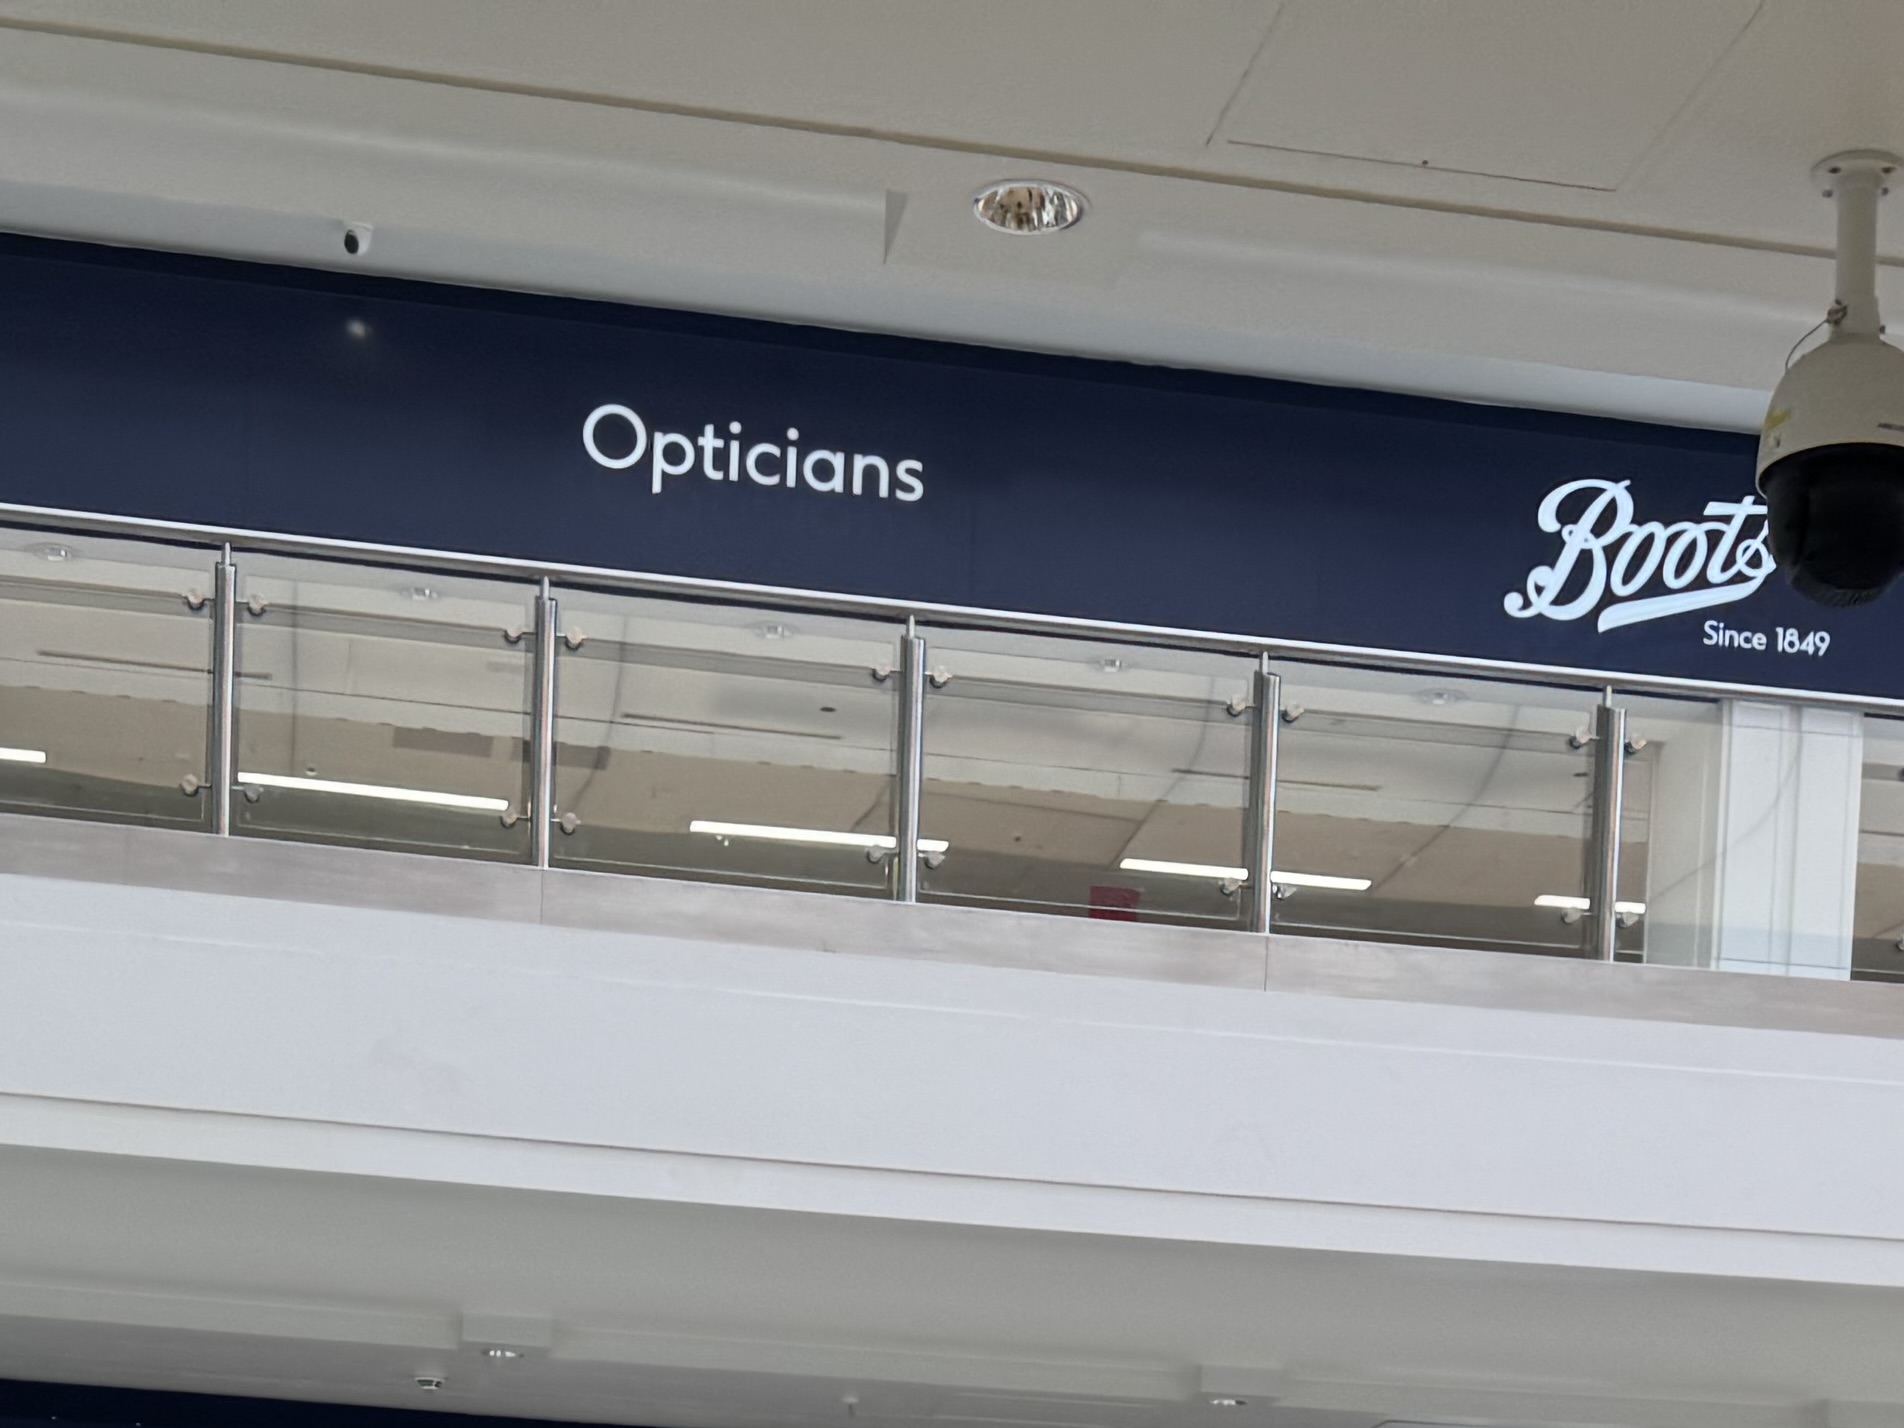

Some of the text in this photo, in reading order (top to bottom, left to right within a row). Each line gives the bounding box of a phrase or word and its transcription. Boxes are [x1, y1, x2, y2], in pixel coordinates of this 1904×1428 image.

[582, 403, 925, 502] Opticians
[1503, 479, 1777, 634] Boots
[1702, 619, 1832, 657] Since 1849
